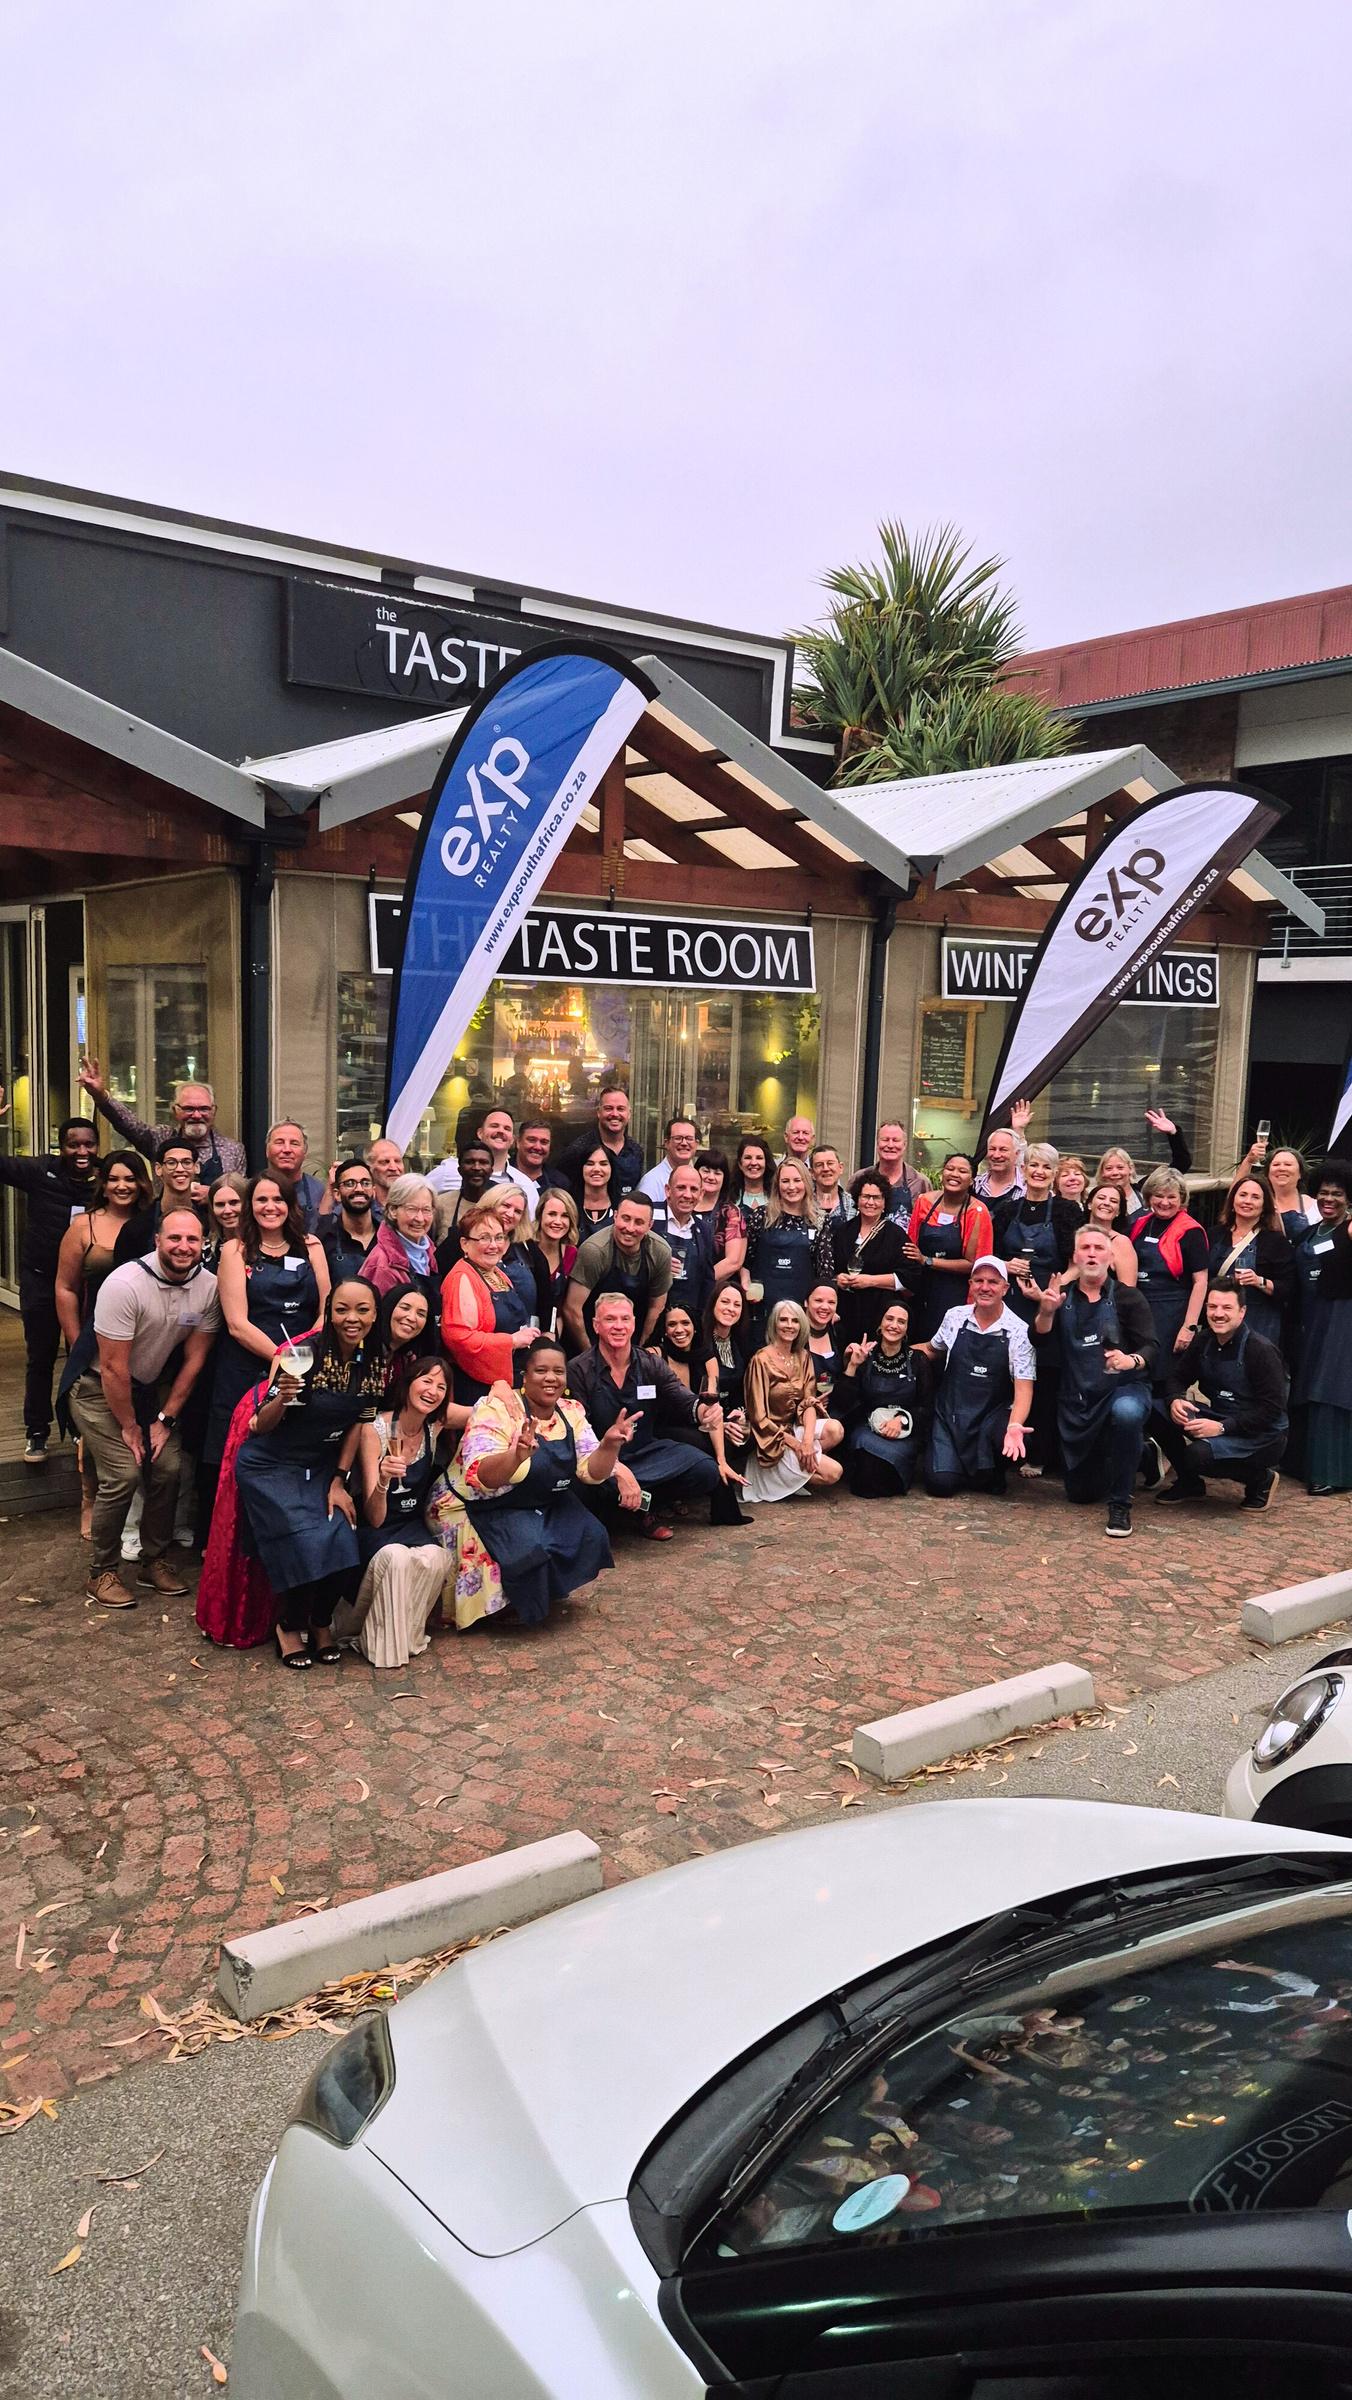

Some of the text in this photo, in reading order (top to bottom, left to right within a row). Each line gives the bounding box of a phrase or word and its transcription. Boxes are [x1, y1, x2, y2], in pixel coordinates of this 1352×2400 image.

[376, 606, 398, 622] the
[474, 809, 519, 888] REALTY
[483, 770, 587, 954] www.expsouthafrica.co.za
[521, 918, 654, 974] TASTE
[666, 928, 800, 982] ROOM
[1105, 896, 1152, 951] REALTY
[1108, 868, 1220, 998] www.expsouthafrica.co.za
